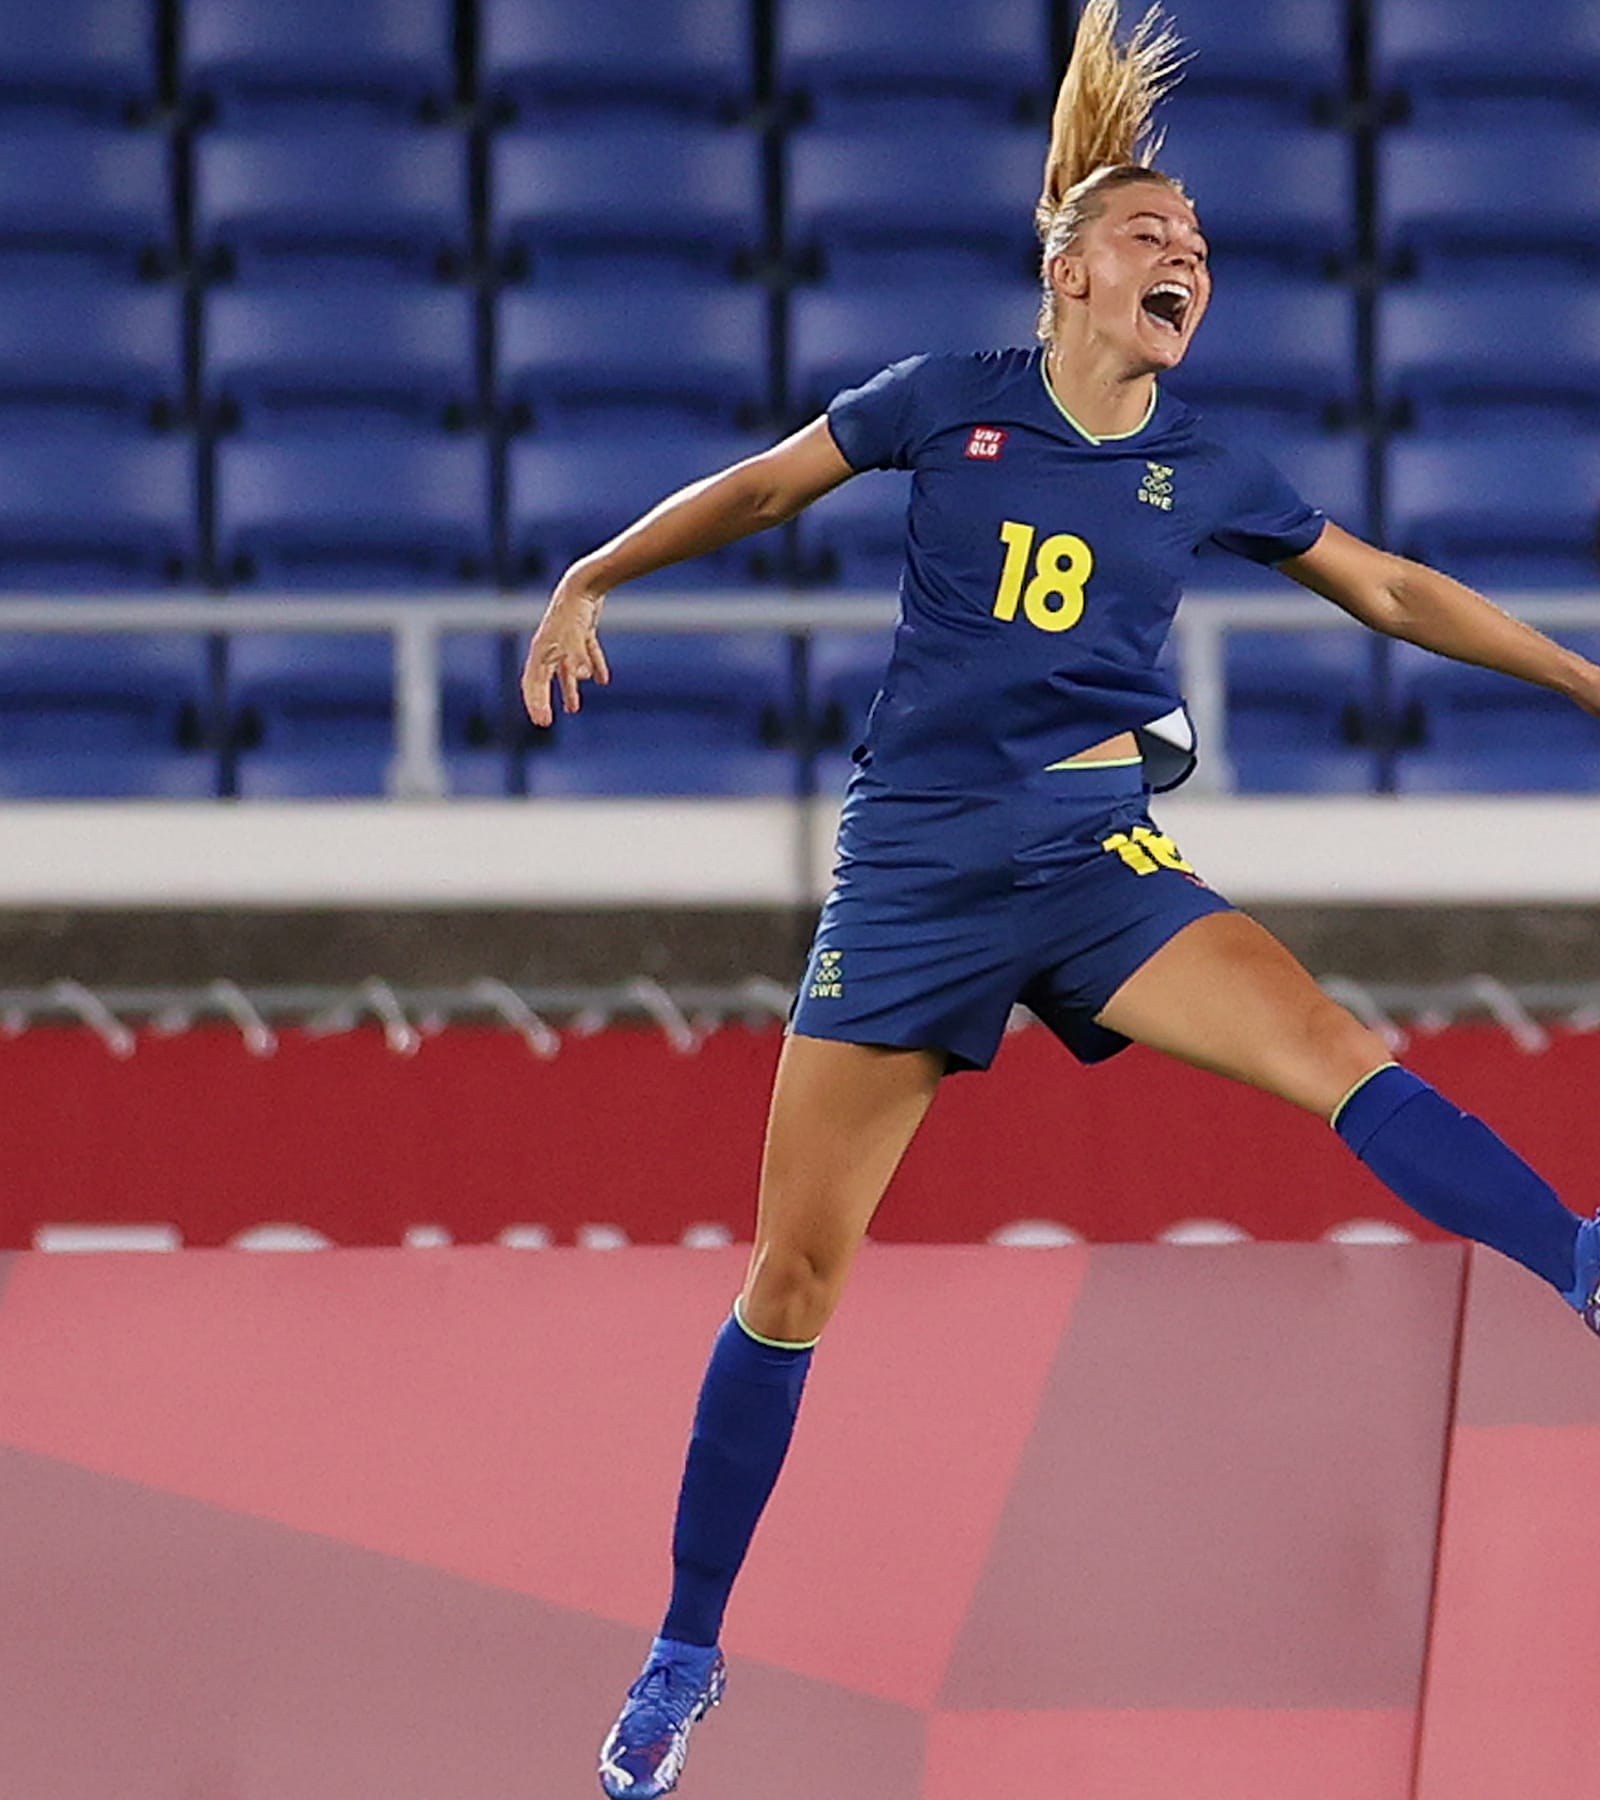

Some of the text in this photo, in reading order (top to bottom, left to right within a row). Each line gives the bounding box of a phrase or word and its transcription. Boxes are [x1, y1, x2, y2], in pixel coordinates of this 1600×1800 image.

[970, 440, 998, 456] QLO
[1137, 488, 1172, 511] SWE
[993, 520, 1093, 632] 18
[809, 983, 843, 999] SWE
